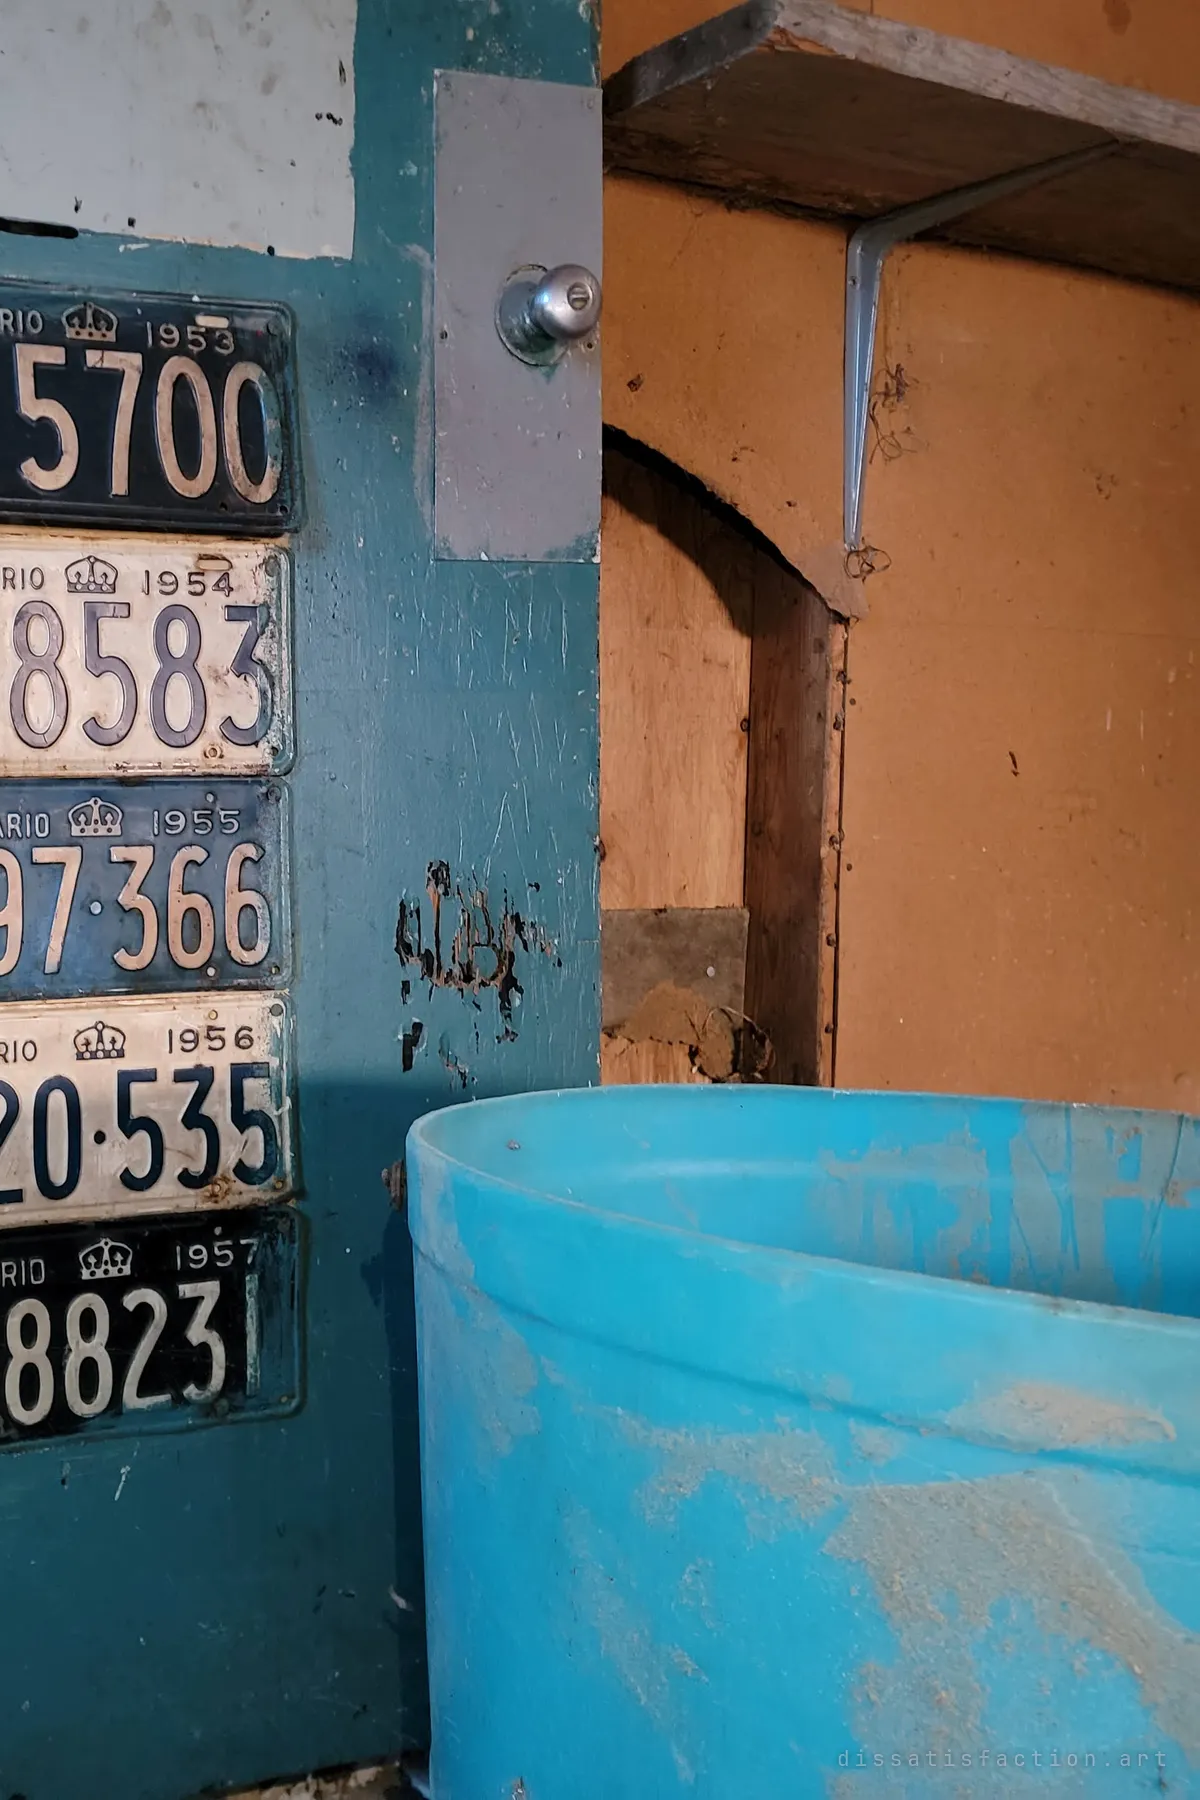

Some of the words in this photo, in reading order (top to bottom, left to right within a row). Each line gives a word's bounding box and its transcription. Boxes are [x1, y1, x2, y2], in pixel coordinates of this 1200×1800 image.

[146, 321, 235, 355] 1953
[144, 569, 233, 597] 1954
[153, 810, 240, 836] 1955
[168, 1025, 254, 1053] 1956
[176, 1238, 259, 1271] 1957
